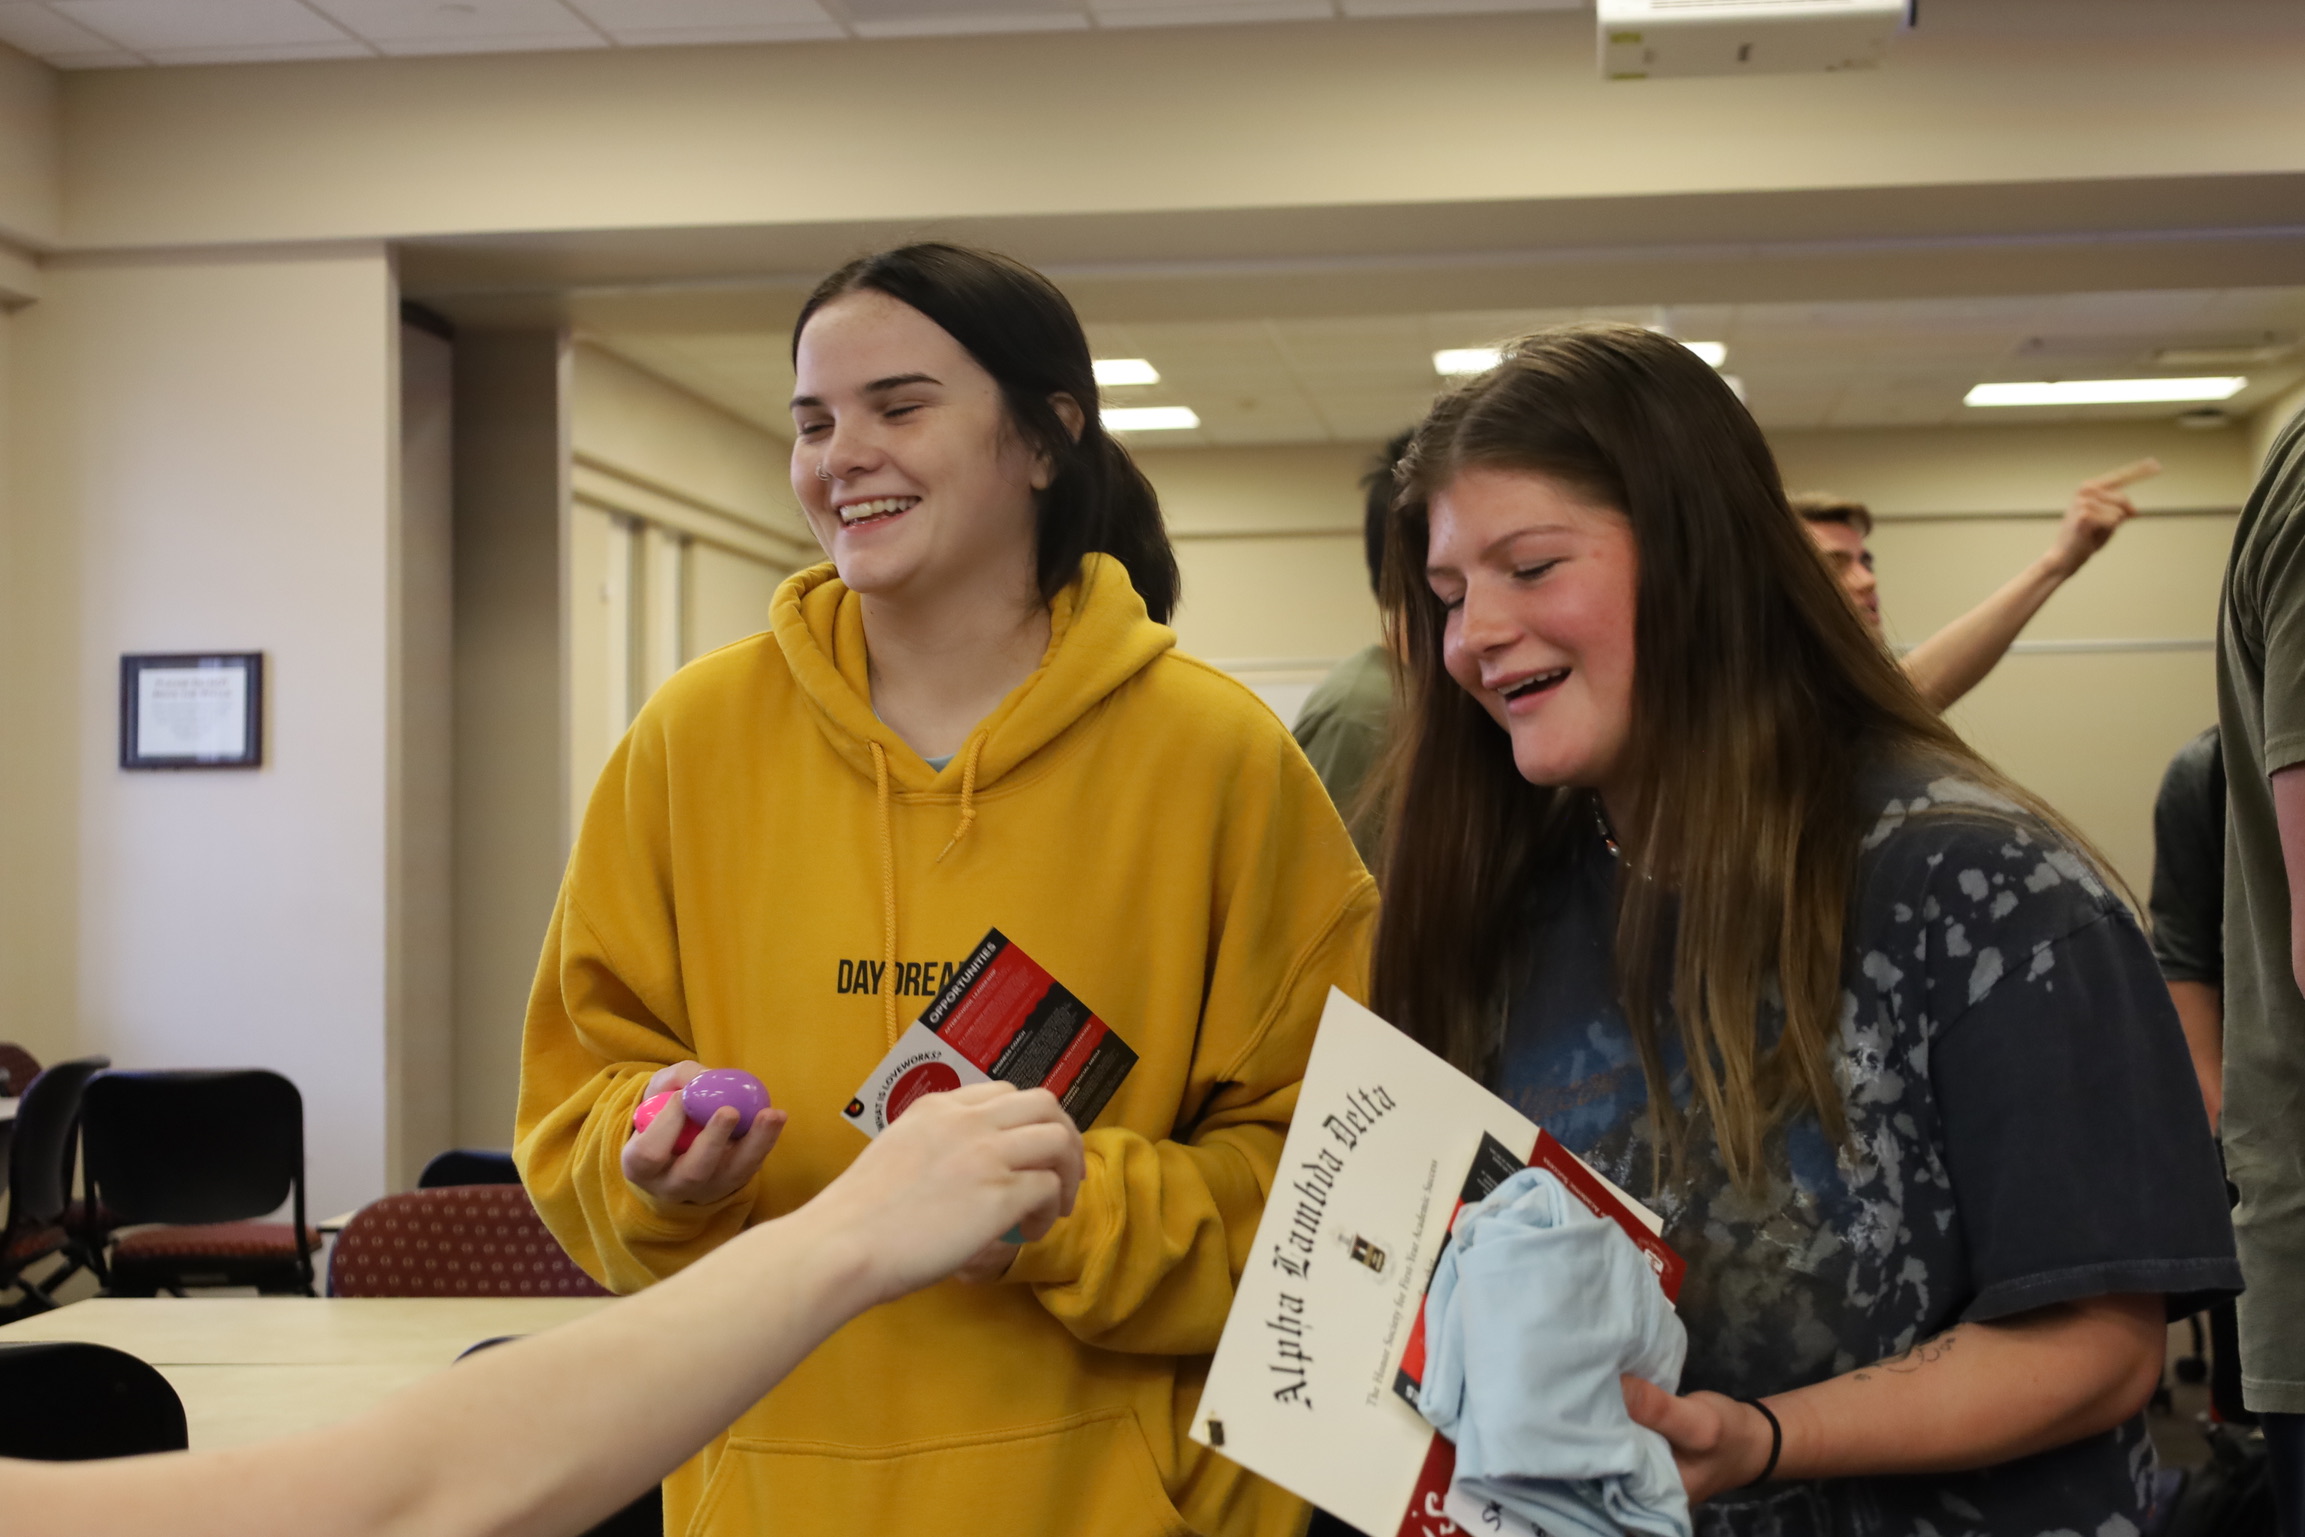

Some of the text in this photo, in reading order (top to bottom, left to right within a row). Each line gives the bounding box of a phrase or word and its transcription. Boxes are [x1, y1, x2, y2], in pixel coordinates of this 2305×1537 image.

[837, 959, 967, 996] DAYDREA
[929, 942, 997, 1024] OPPORTUNITIES
[1010, 1030, 1027, 1050] COACH
[877, 1090, 887, 1102] IS
[882, 1050, 942, 1091] LOVEWORKS?
[1422, 1158, 1438, 1193] Success
[1412, 1194, 1430, 1240] Academic
[1265, 1084, 1397, 1411] Alpha Lambda Delta
[1398, 1241, 1420, 1291] First-Year
[1393, 1291, 1407, 1308] for
[1383, 1309, 1403, 1347] Society
[1372, 1348, 1390, 1384] Honor
[1365, 1386, 1380, 1407] The
